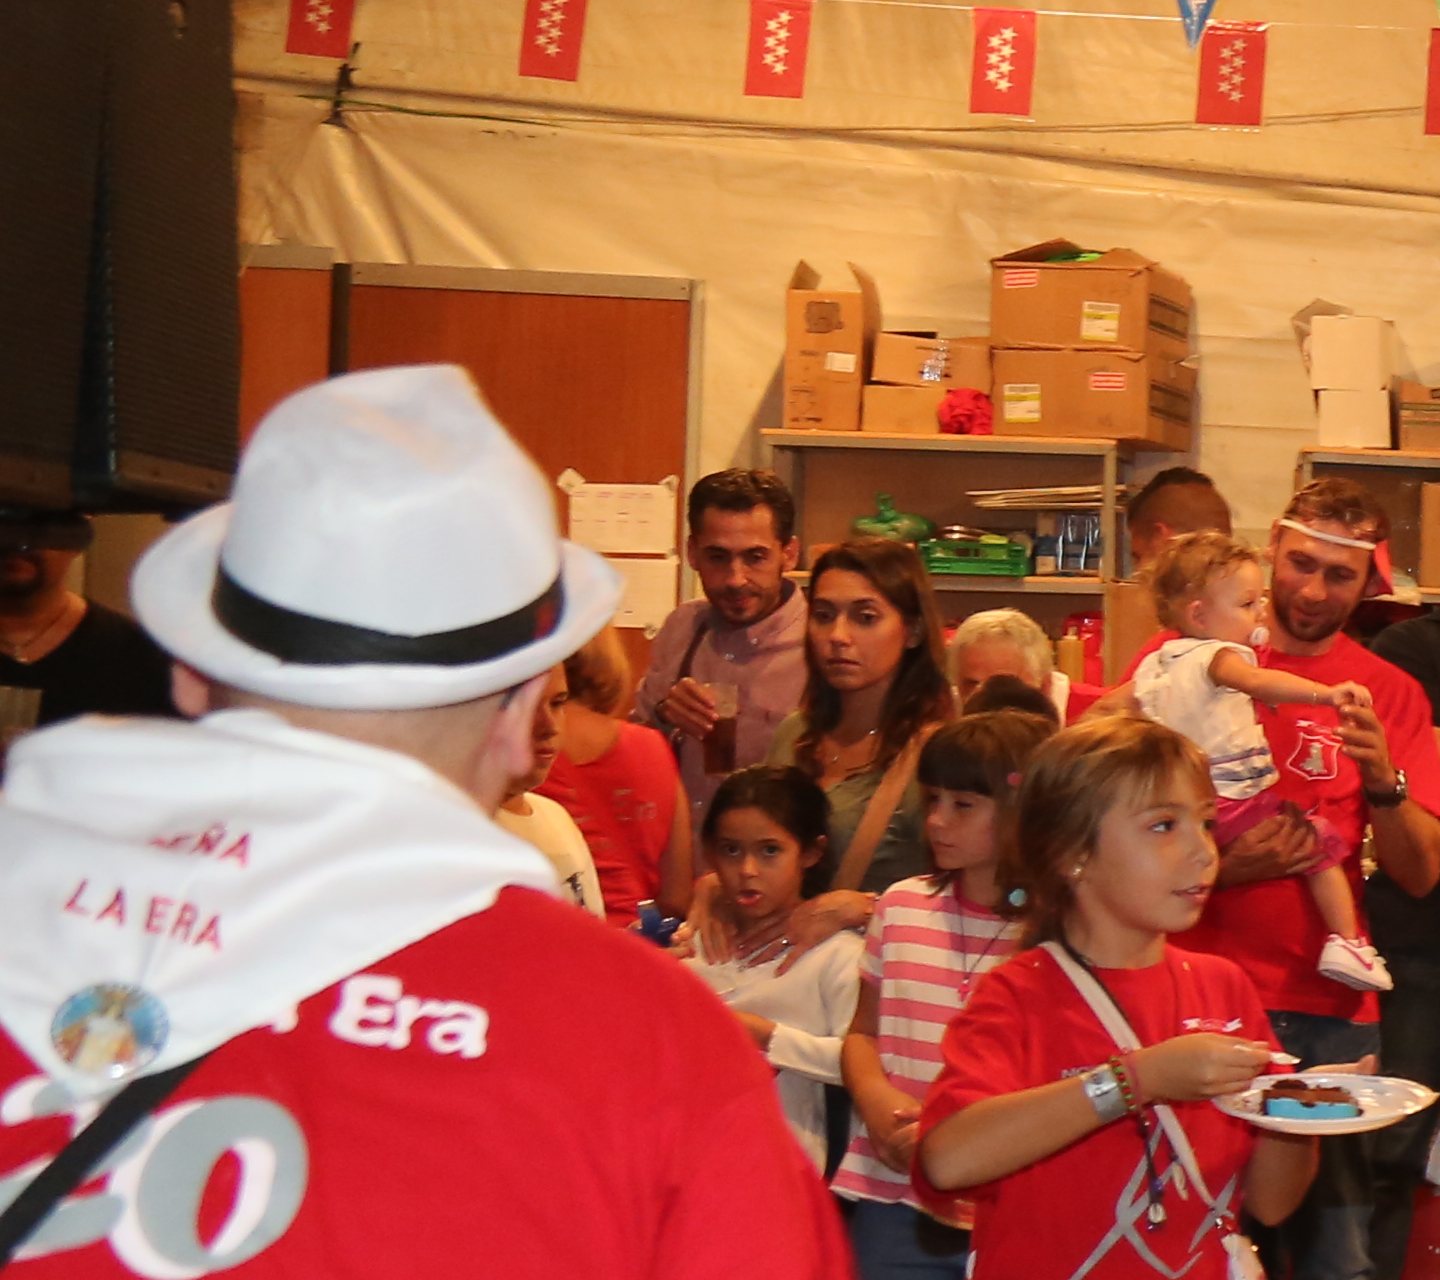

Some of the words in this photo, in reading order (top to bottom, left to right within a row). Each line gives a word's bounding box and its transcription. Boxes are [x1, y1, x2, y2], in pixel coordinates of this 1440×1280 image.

[63, 878, 127, 926] LA
[145, 894, 223, 952] ERA
[329, 972, 489, 1059] Era
